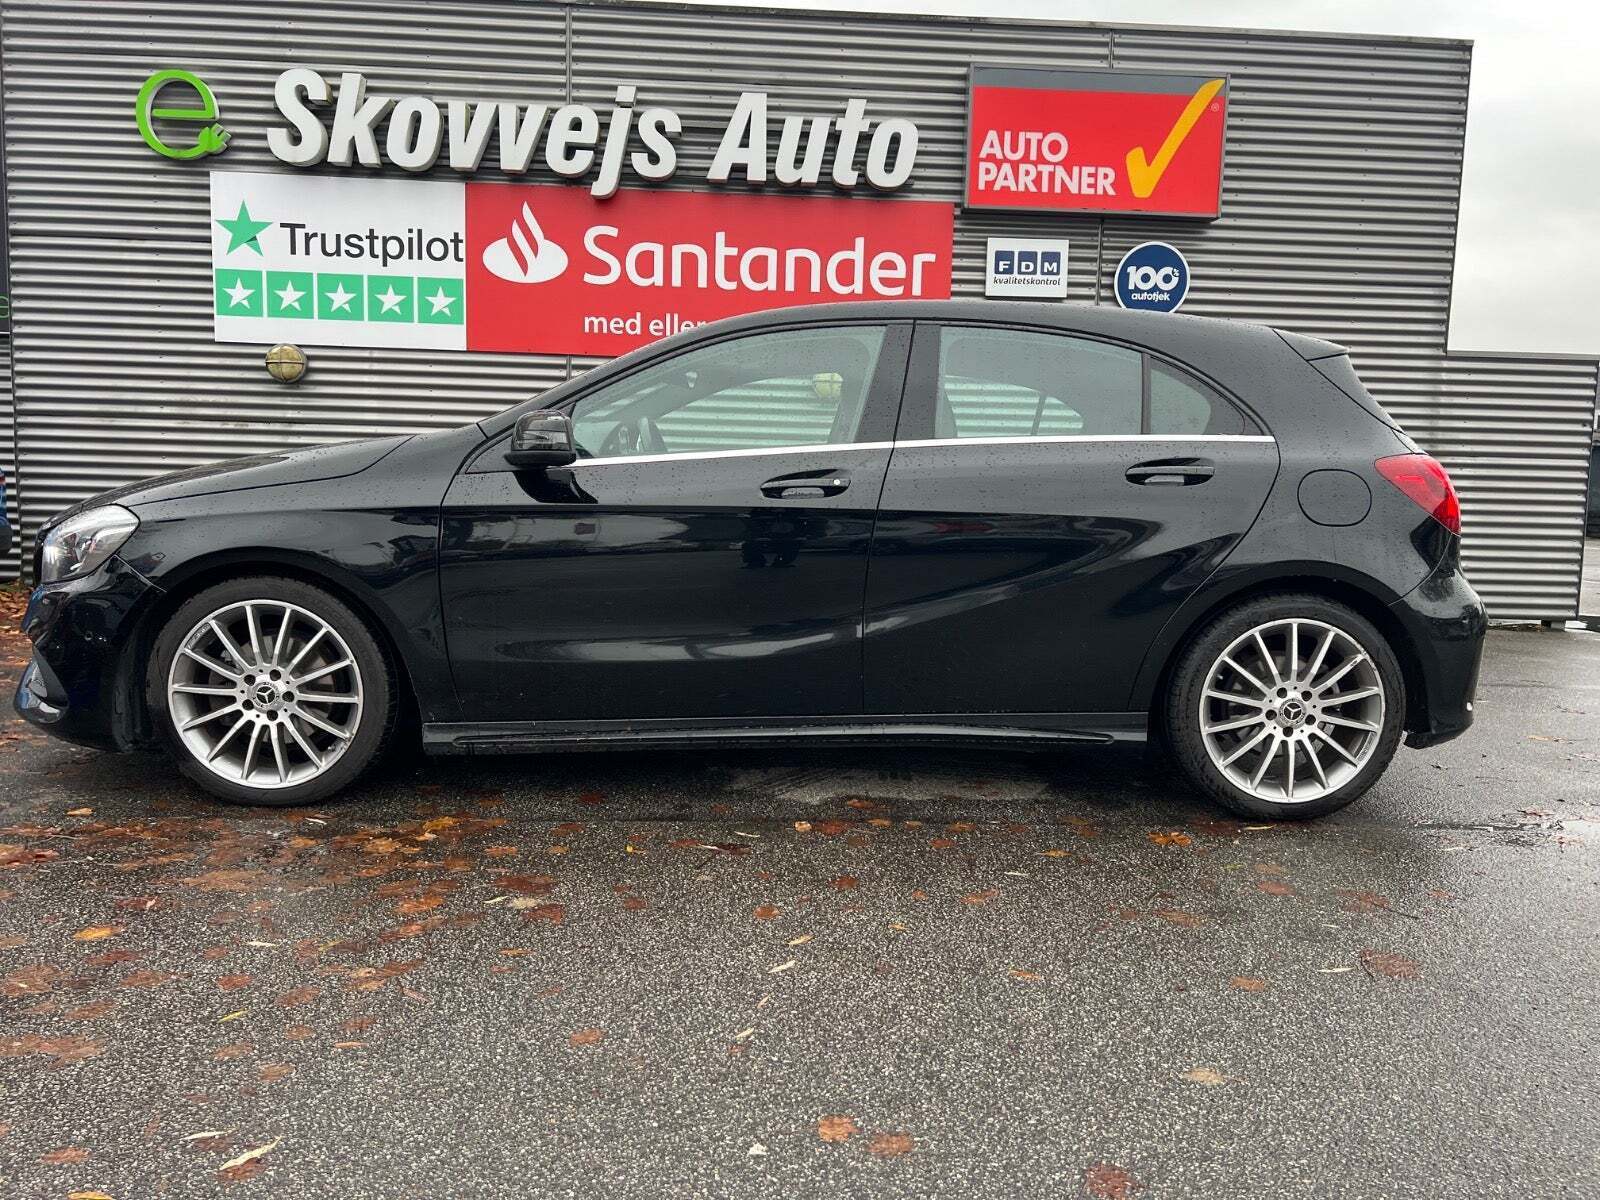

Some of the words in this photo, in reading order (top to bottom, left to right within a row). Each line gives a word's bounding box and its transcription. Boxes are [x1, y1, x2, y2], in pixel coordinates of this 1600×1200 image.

[267, 67, 683, 199] Skovvejs
[706, 91, 919, 191] Auto
[978, 130, 1068, 162] AUTO
[977, 162, 1117, 196] PARTNER
[279, 222, 464, 267] Trustpilot
[583, 225, 937, 297] Santander
[998, 260, 1058, 273] FDM
[993, 275, 1061, 287] kvalitetskontrol
[1131, 291, 1171, 302] autotjek
[583, 311, 642, 335] med
